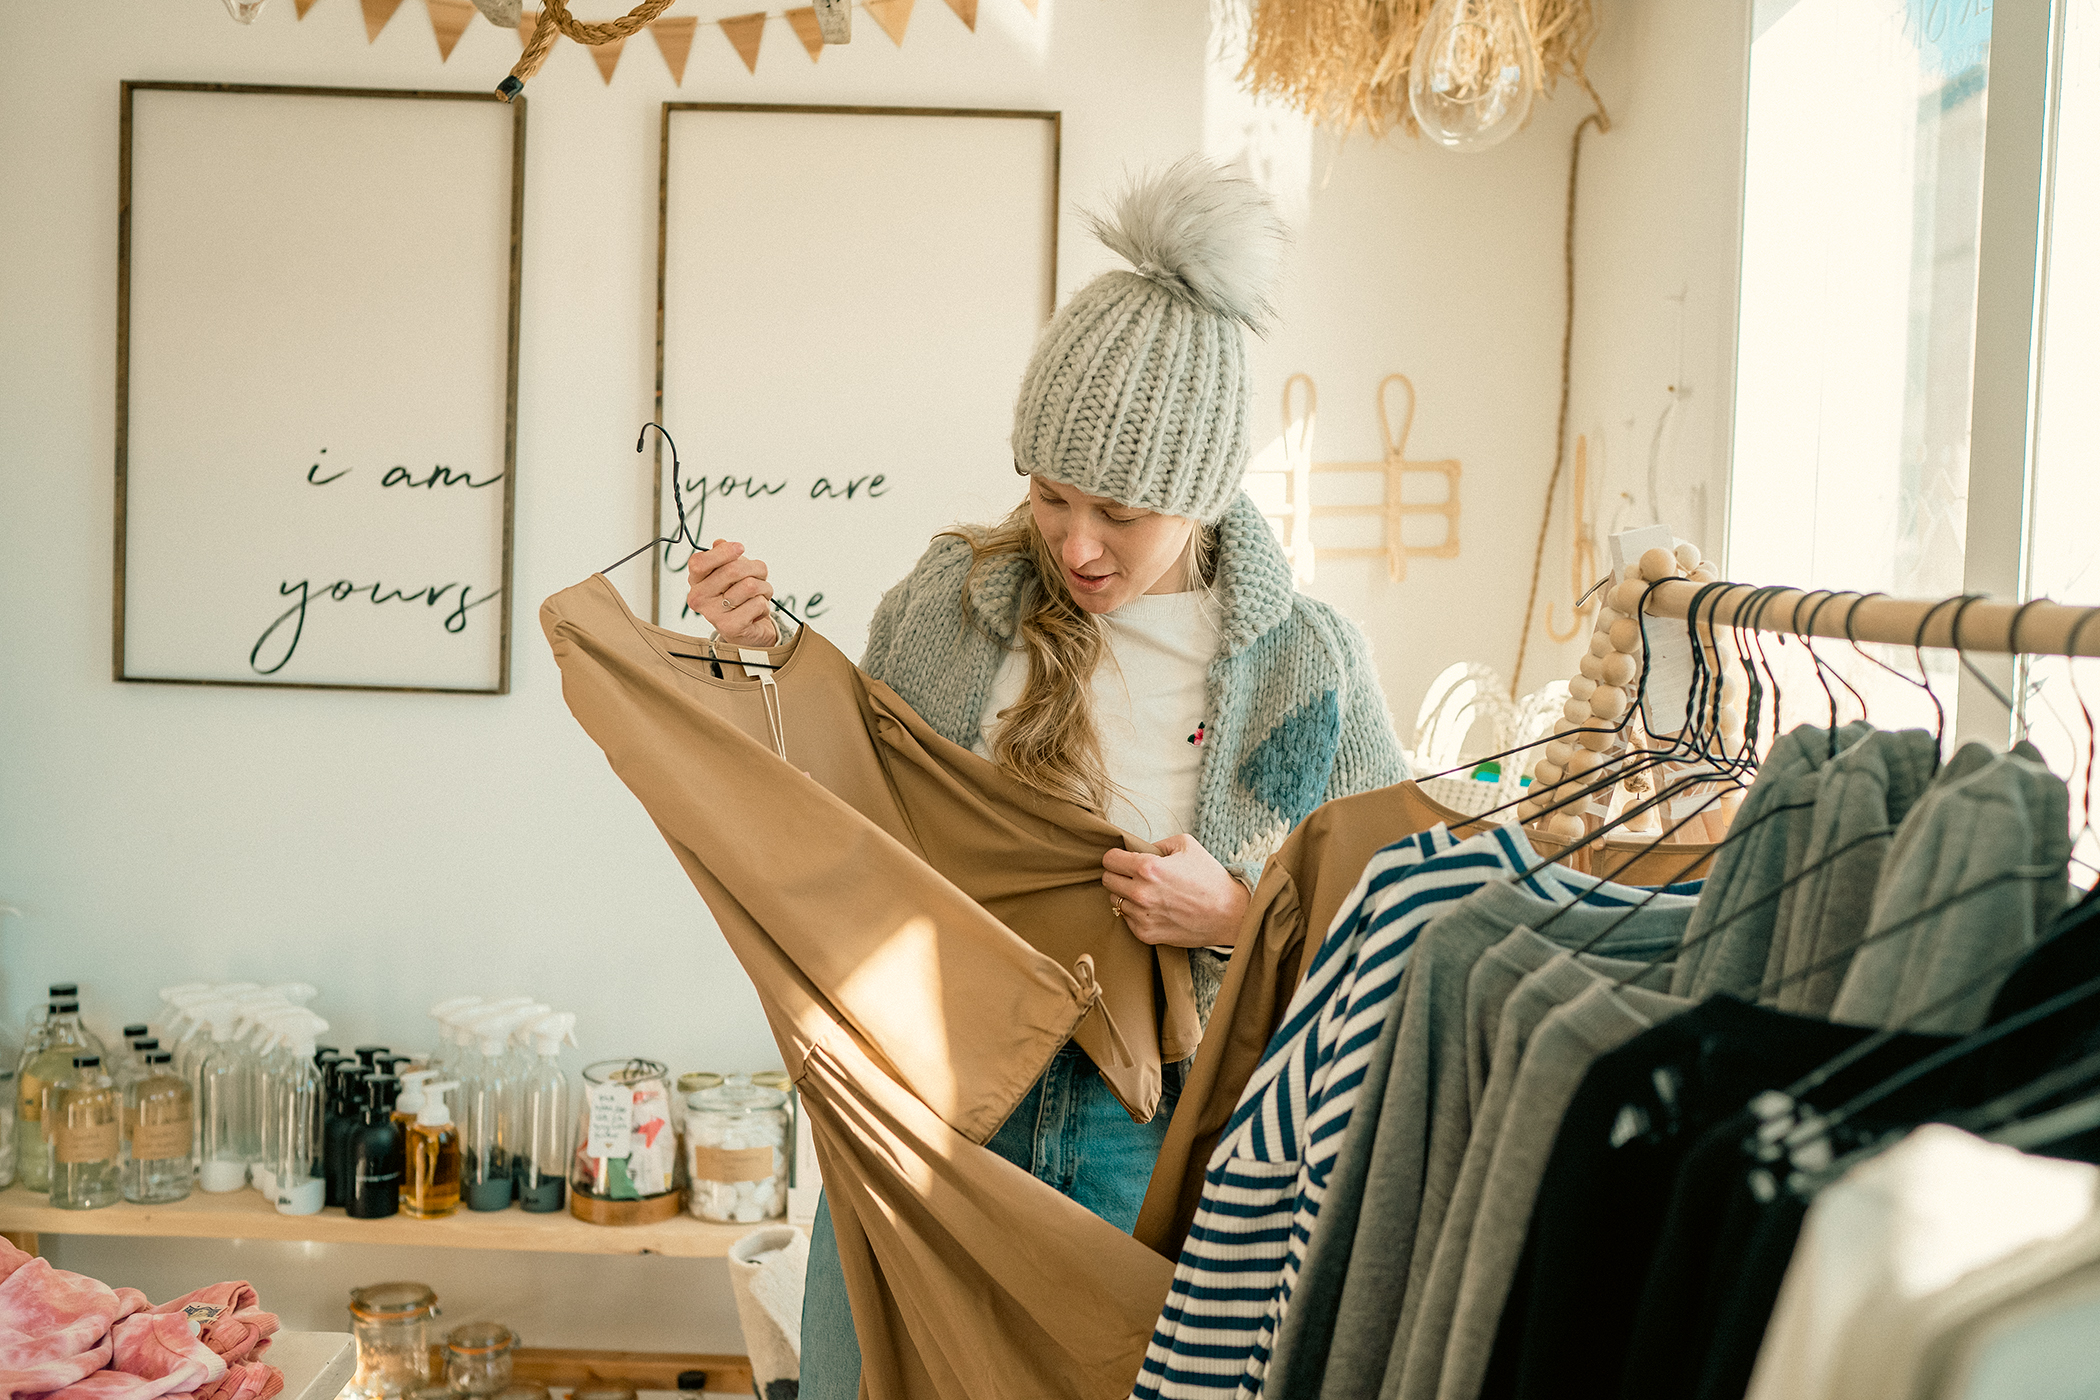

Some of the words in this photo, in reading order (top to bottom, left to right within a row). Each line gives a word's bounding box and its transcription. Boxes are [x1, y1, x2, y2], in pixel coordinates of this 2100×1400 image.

[307, 448, 352, 486] i
[380, 464, 504, 489] am
[664, 474, 787, 572] you
[809, 473, 891, 500] are
[250, 579, 502, 675] yours
